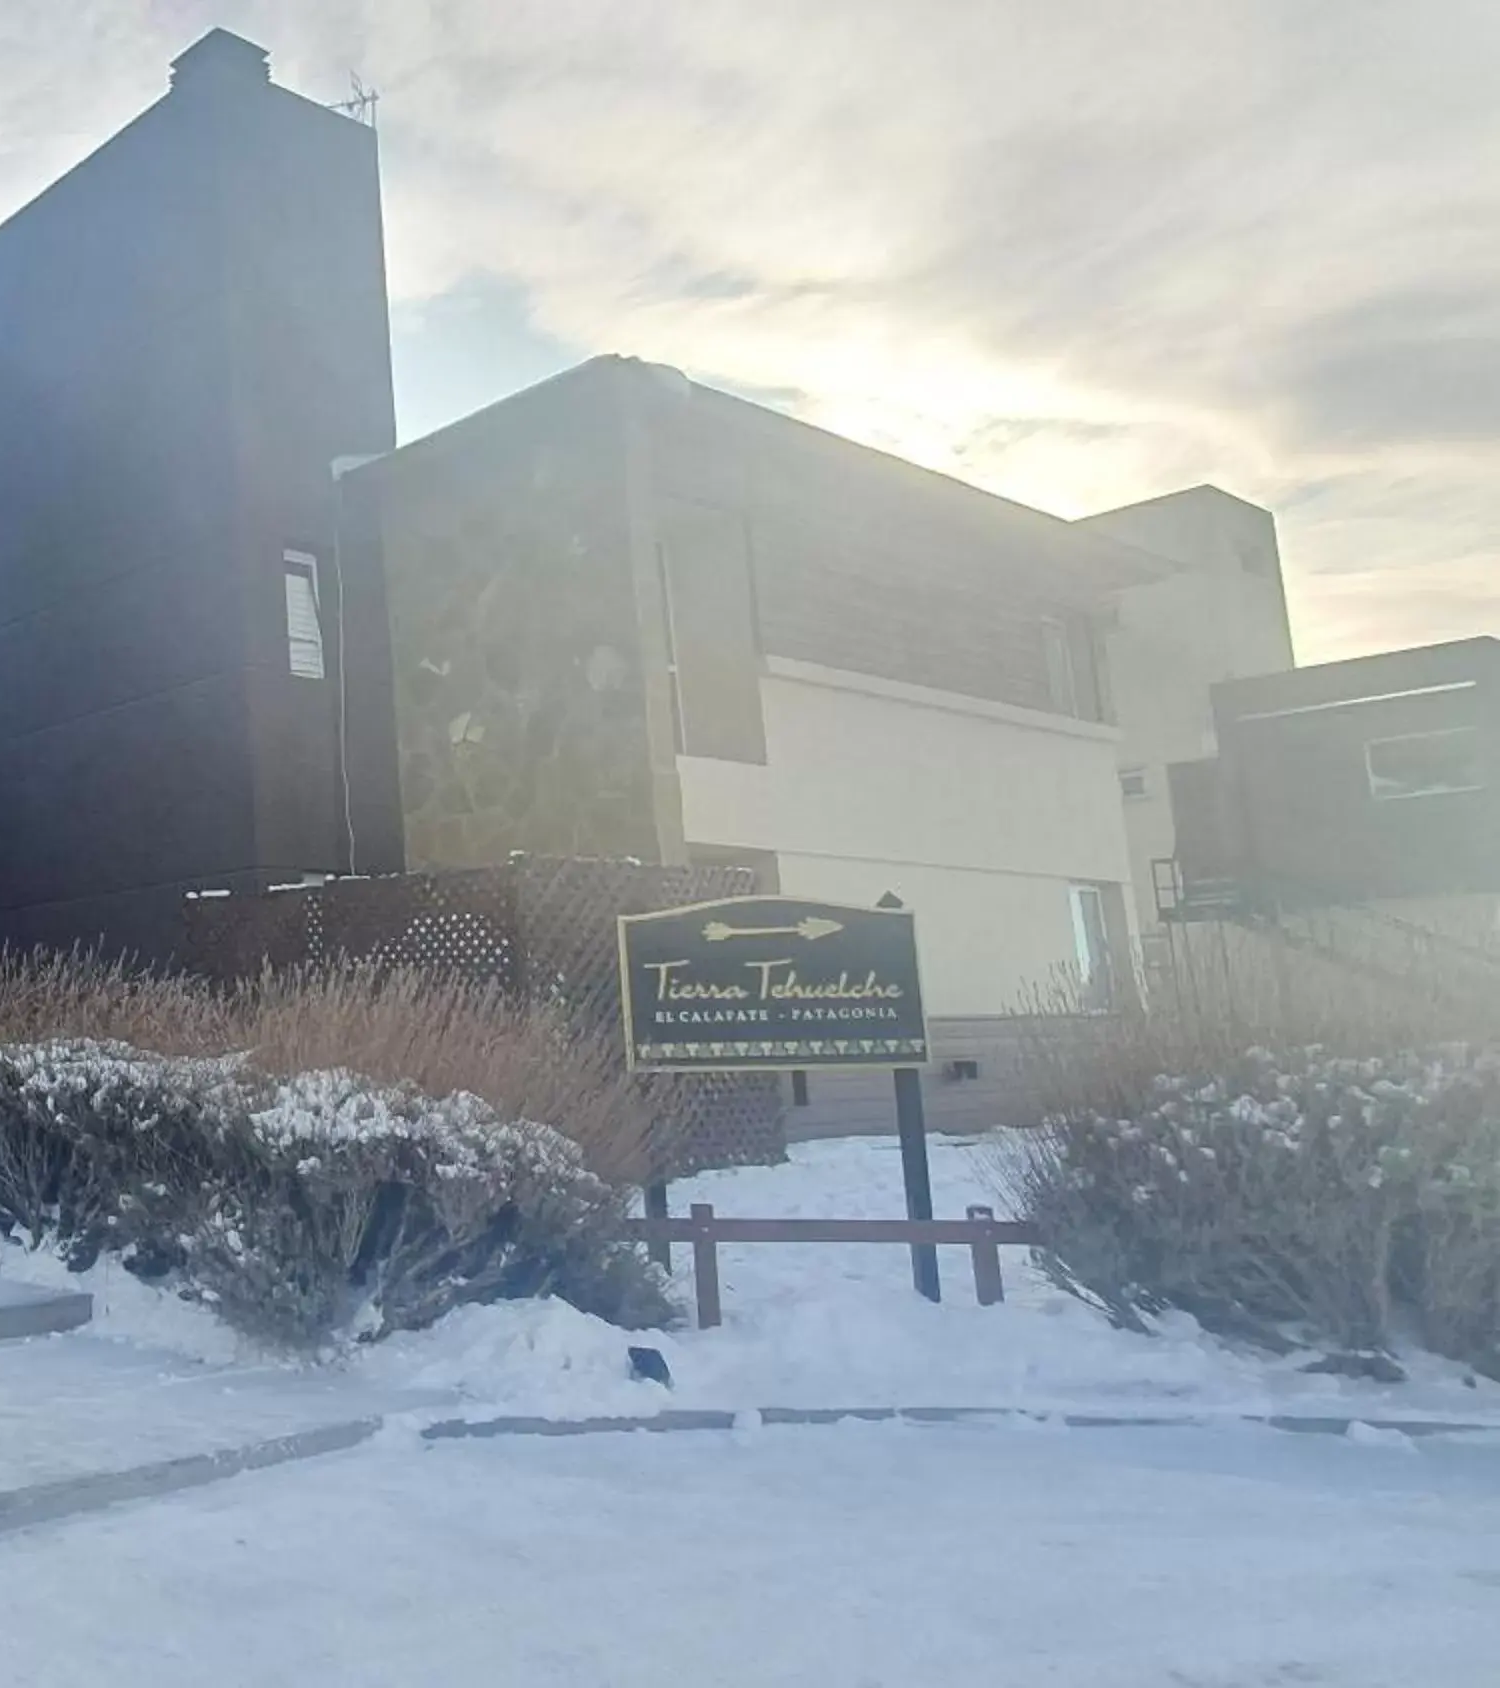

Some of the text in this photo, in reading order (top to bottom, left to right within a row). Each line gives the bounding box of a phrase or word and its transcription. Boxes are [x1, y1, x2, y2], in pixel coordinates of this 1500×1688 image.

[643, 958, 904, 1000] Tierra Tehuelche
[655, 1010, 675, 1023] EL
[679, 1008, 769, 1022] CALAFATE
[791, 1007, 898, 1021] PATAGONIA
